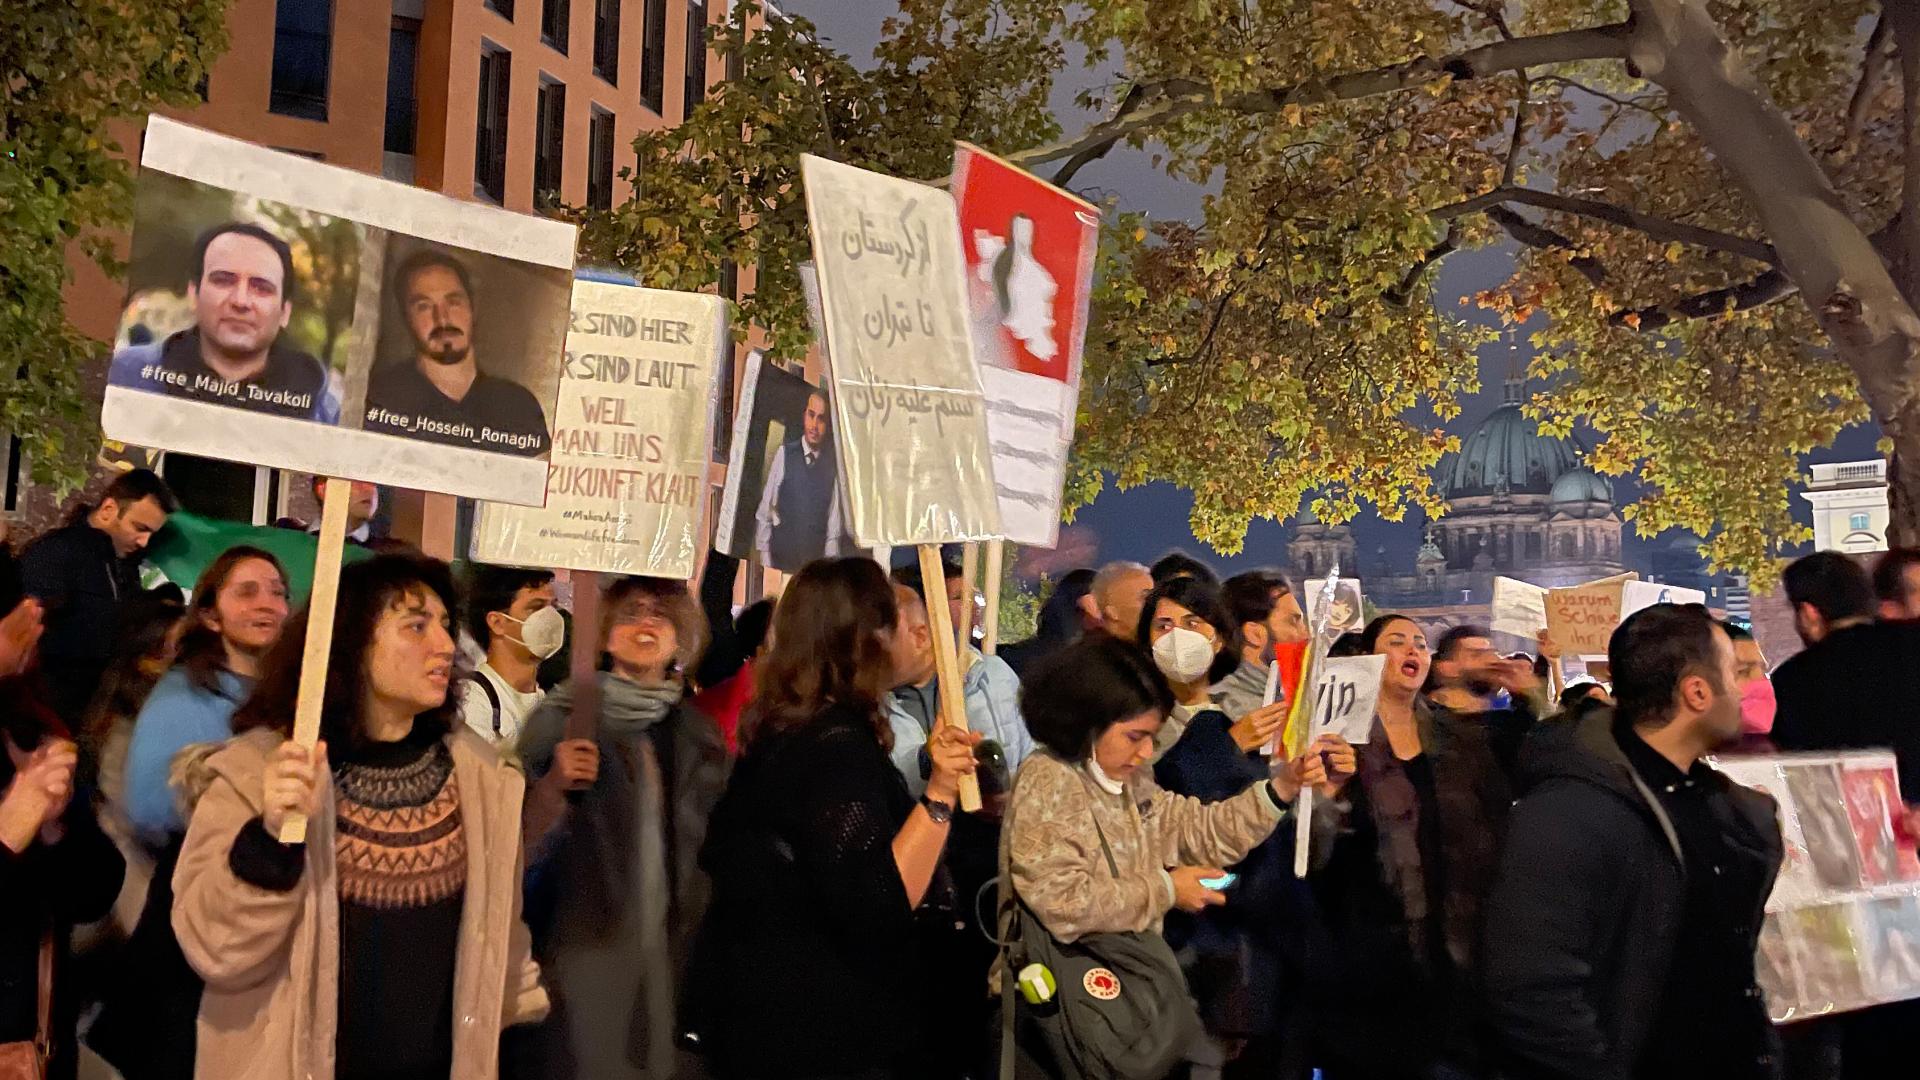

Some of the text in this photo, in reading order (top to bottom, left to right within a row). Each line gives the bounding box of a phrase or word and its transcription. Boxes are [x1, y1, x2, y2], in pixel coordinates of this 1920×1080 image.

[917, 219, 932, 275] از
[640, 317, 693, 344] HIER
[864, 293, 935, 349] تا تهران
[141, 364, 311, 409] #free_Majid_Tavakoli
[635, 358, 696, 389] LAUT
[367, 407, 541, 449] #free_Hossein_Ronaghi
[580, 396, 635, 427] WEIL
[614, 431, 663, 463] UNS
[548, 464, 643, 500] ZUKUNFT
